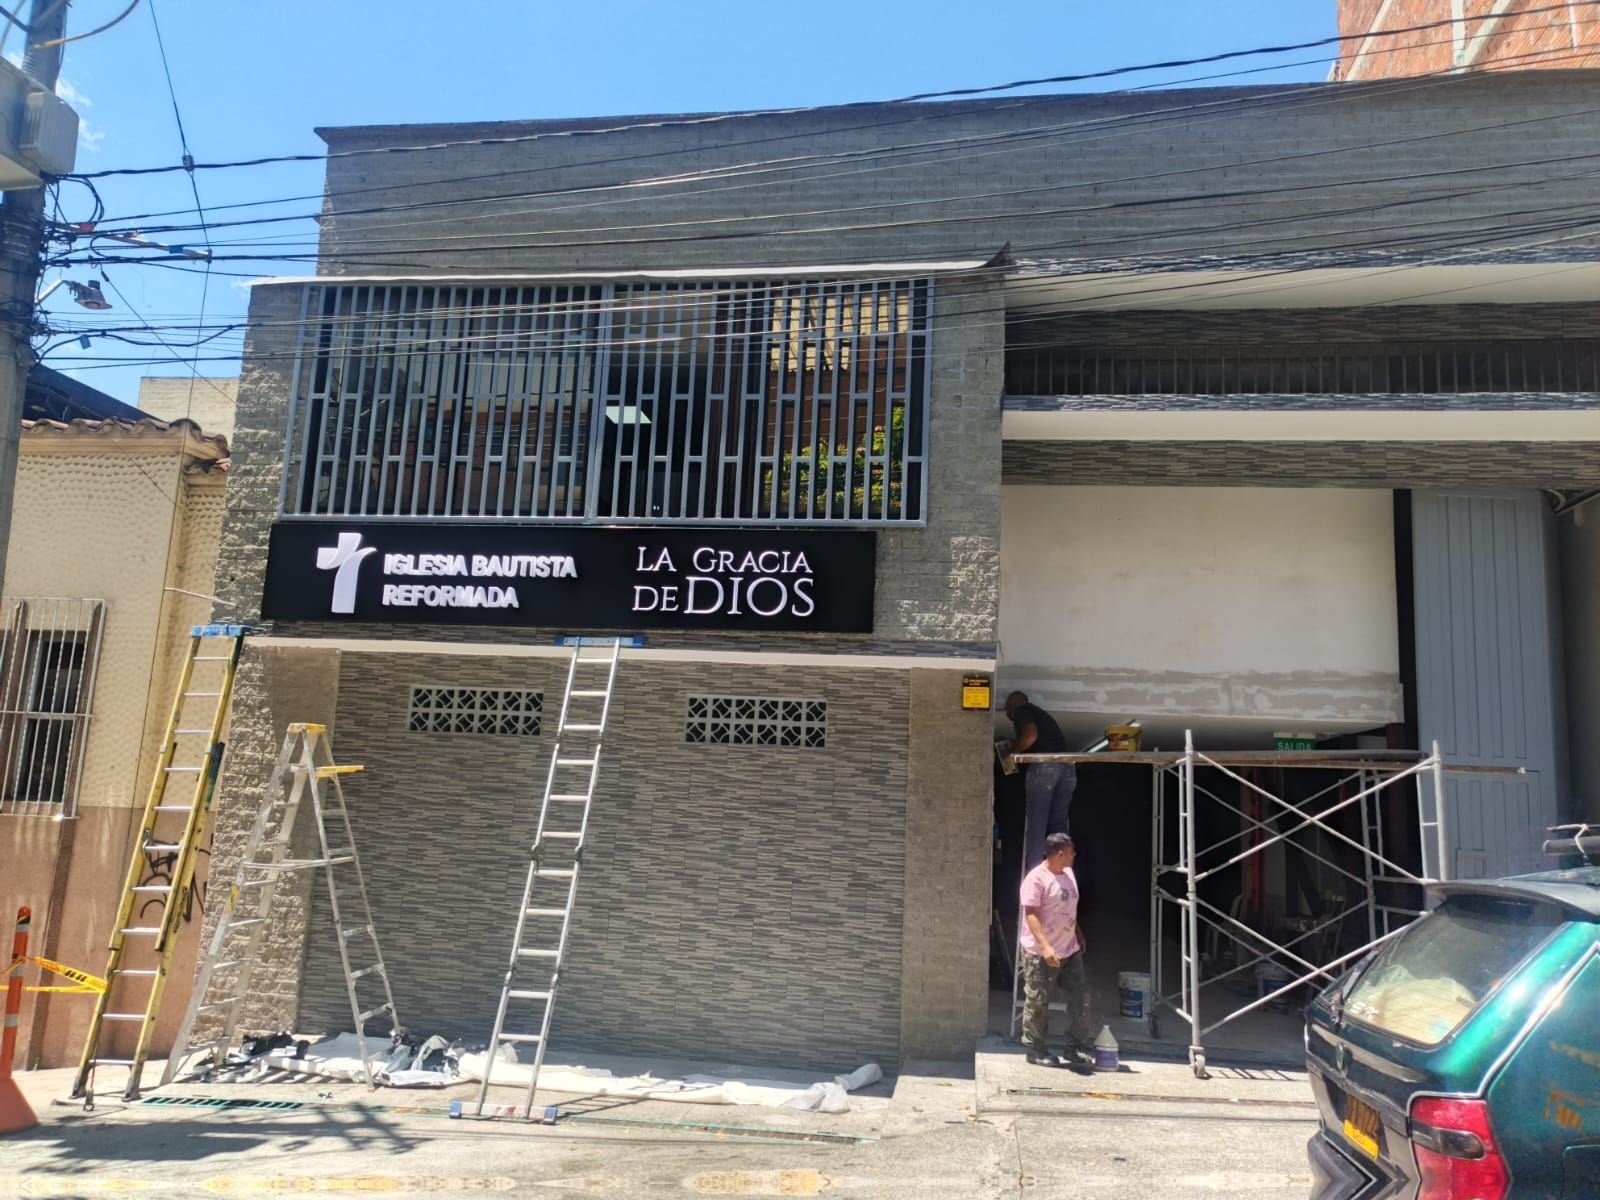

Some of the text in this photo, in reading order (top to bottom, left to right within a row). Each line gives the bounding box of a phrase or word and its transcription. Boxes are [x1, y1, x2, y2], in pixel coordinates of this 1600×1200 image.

[383, 553, 578, 578] IGLESIA BAUTISTA
[635, 546, 814, 574] LA GRACIA
[382, 584, 520, 609] REFORMADA
[631, 576, 815, 617] DE DIOS
[1277, 741, 1313, 752] SALIDA
